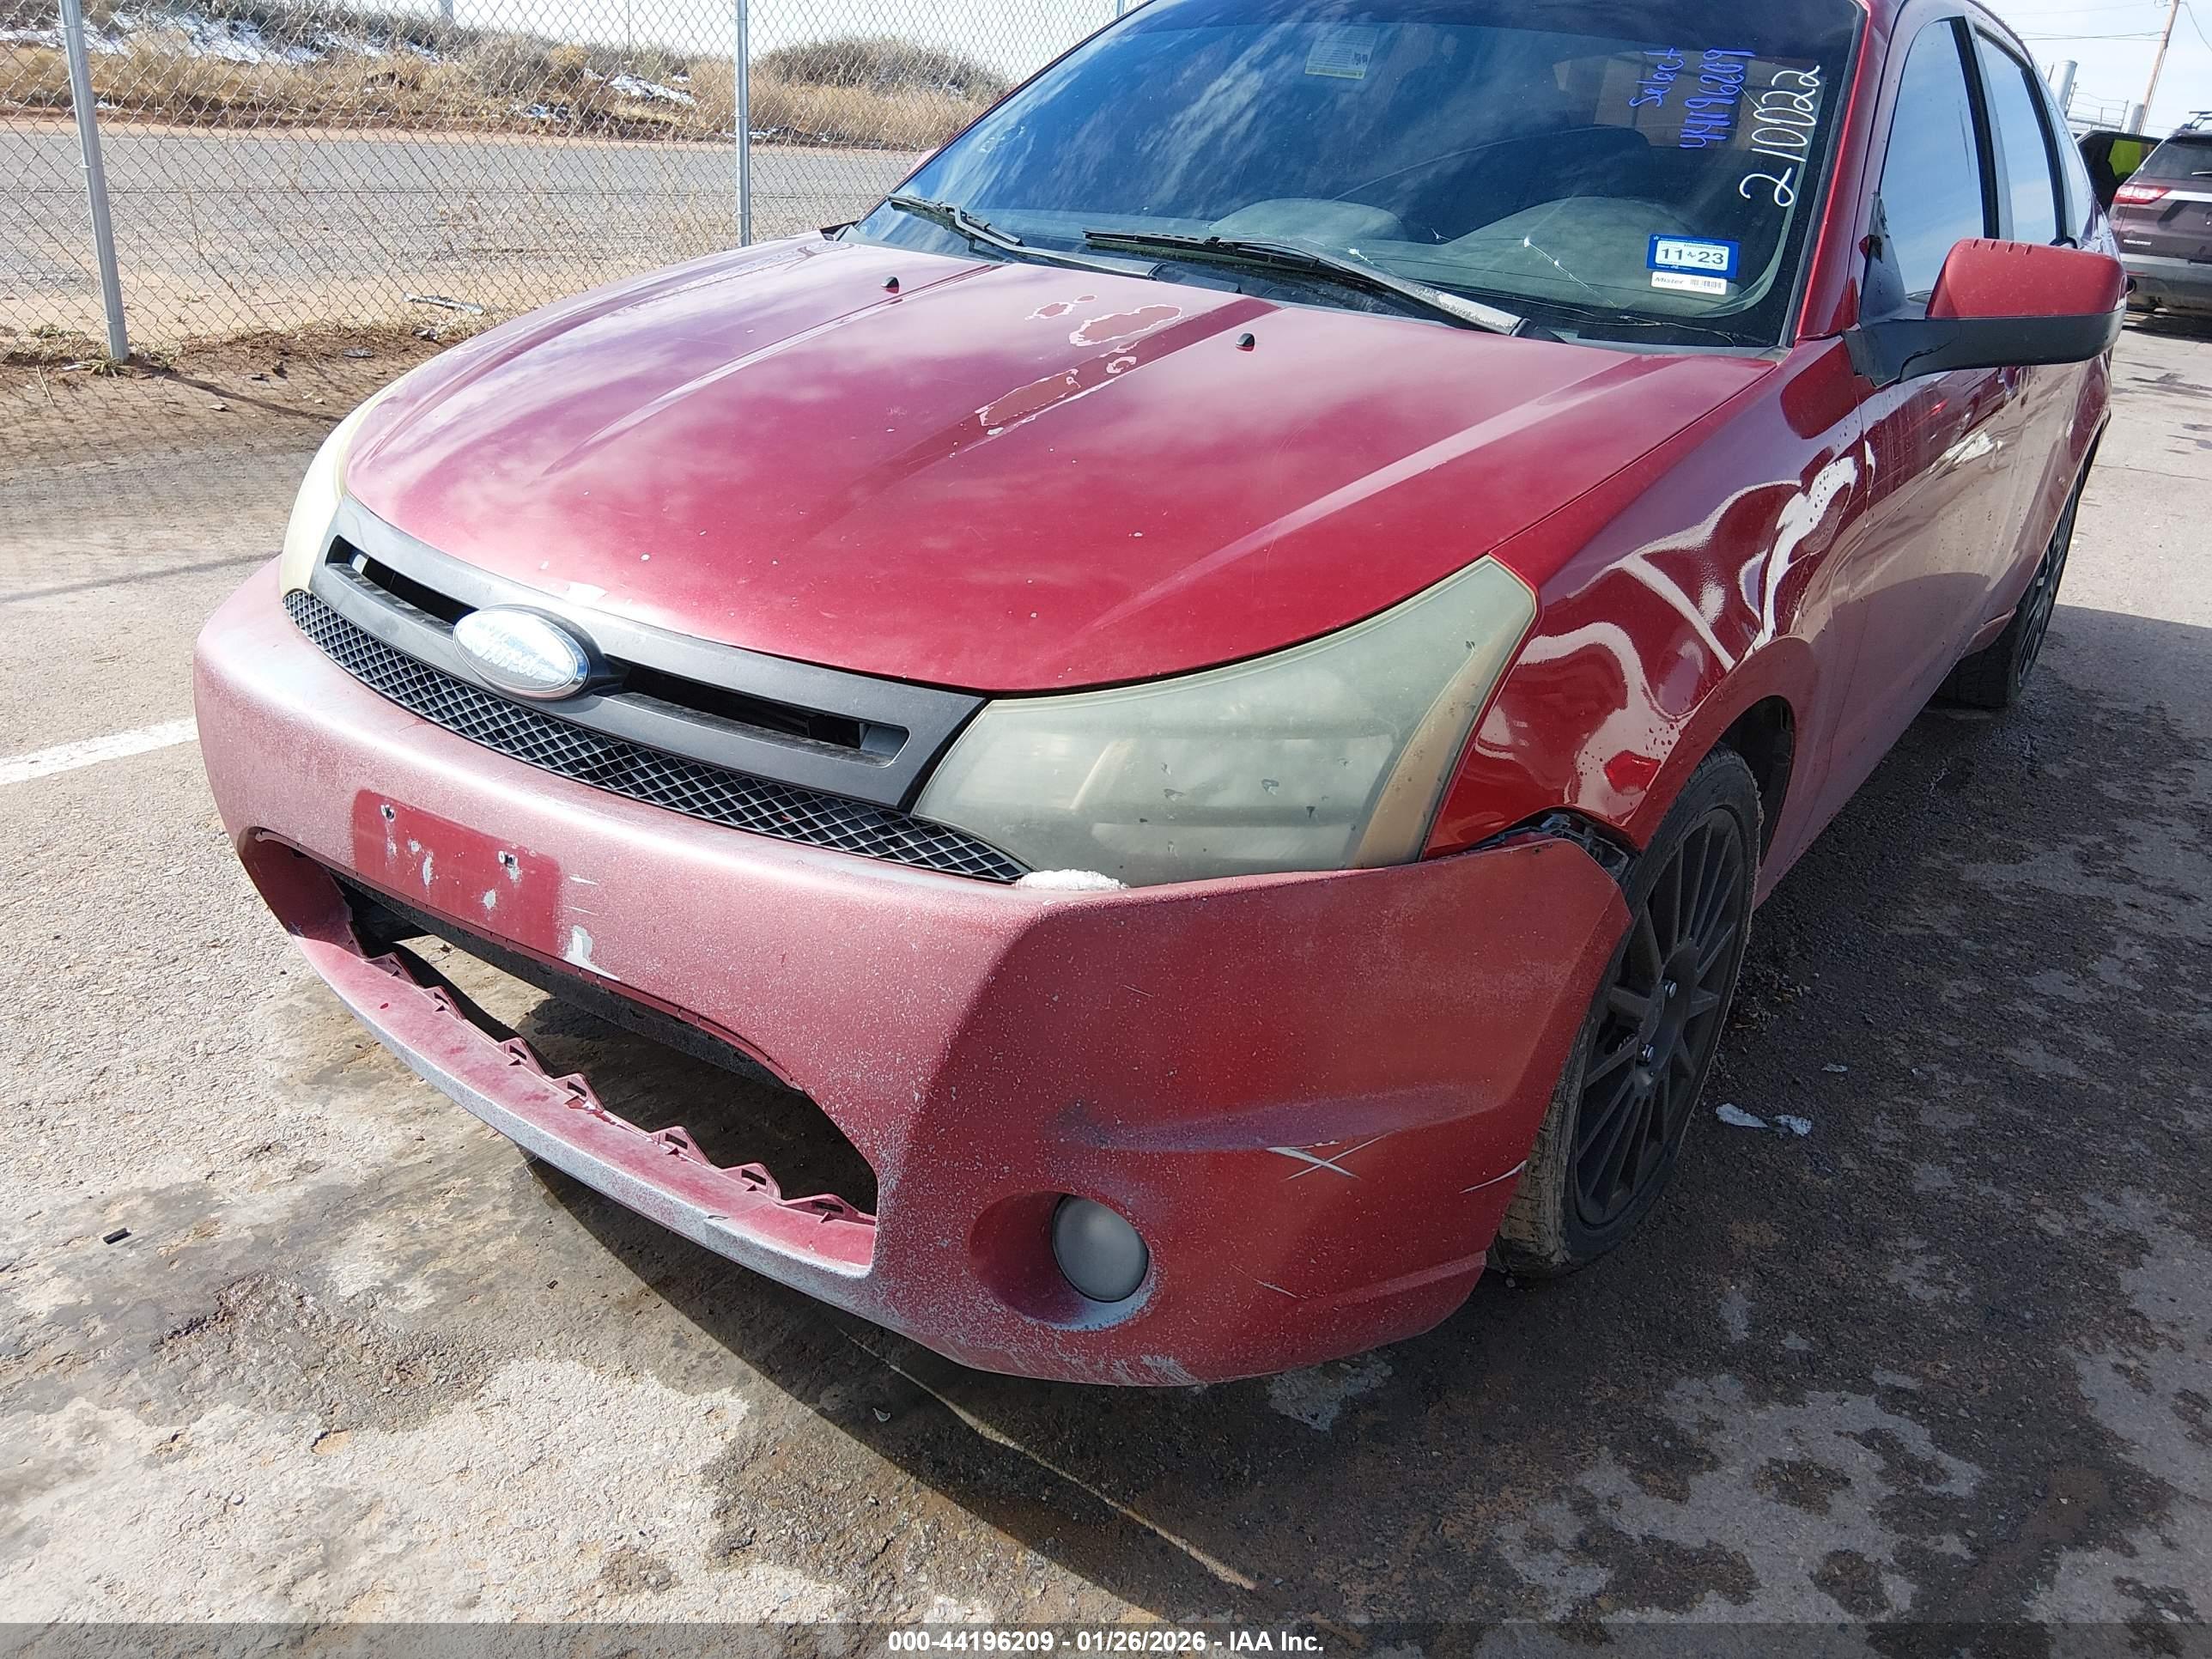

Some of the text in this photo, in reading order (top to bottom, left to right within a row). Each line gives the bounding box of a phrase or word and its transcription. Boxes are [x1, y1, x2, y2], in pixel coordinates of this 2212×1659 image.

[1628, 47, 1684, 107] Select
[1679, 48, 1756, 149] 44196209
[1739, 64, 1820, 207] 210022
[1662, 247, 1724, 264] 11 23
